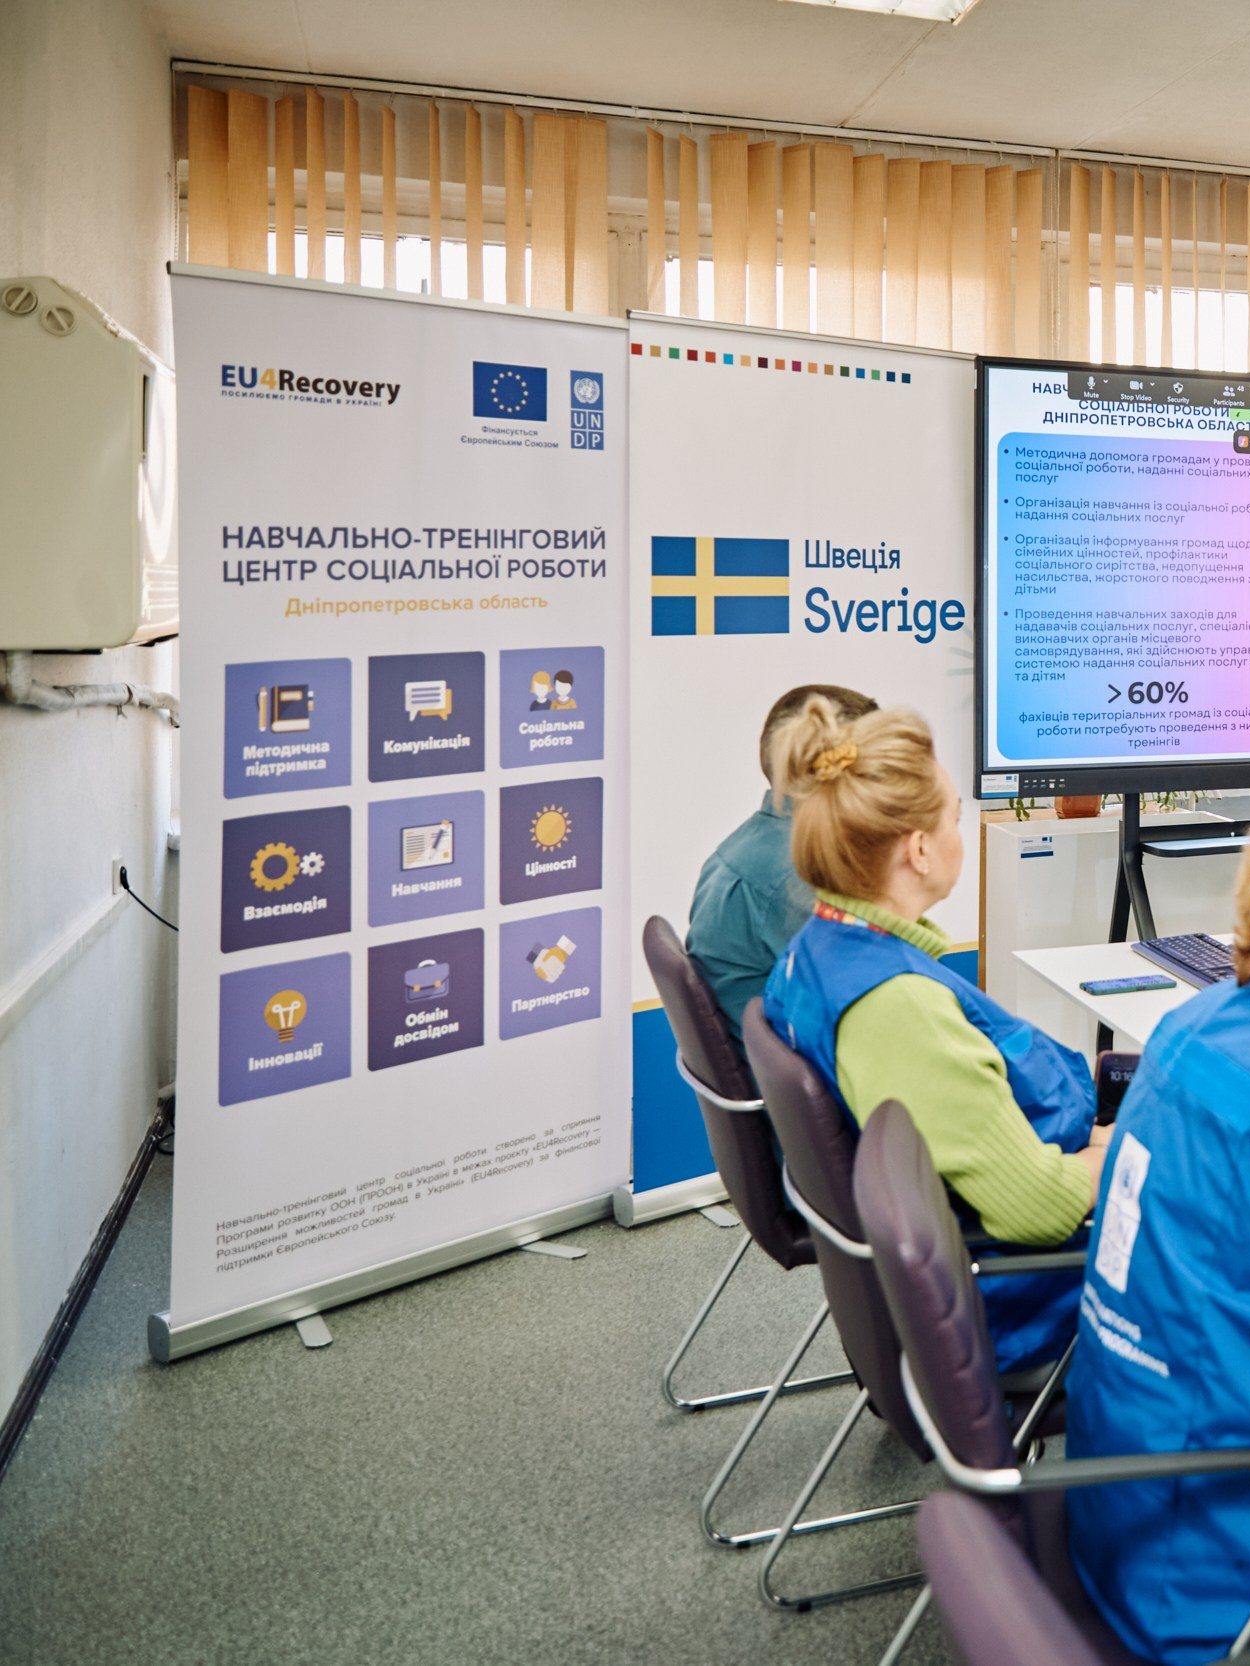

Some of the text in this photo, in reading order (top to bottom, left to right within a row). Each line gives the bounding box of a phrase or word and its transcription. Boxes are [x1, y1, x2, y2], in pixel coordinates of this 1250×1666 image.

[221, 364, 401, 405] EU4Recovery
[221, 390, 285, 400] ПОСИЛЮЄМО
[289, 395, 332, 404] ГРОМАДИ
[1121, 393, 1152, 402] Stop Video
[1167, 396, 1190, 404] Security
[1213, 399, 1245, 407] Participants
[1043, 412, 1194, 429] ДНІПРОПЕТРОВСЬКА
[481, 425, 538, 437] Фінансується
[460, 435, 559, 448] Європейським Союзом
[1015, 447, 1086, 463] Методична
[1088, 452, 1149, 465] допомога
[1151, 454, 1210, 468] громадам
[1213, 457, 1219, 468] у
[1014, 497, 1089, 512] Організація
[1092, 501, 1150, 511] навчання
[1153, 500, 1162, 511] із
[1165, 500, 1228, 514] соціальної
[222, 526, 606, 550] НАВЧАЛЬНО-ТРЕНІНГОВИЙ
[1014, 534, 1089, 549] Організація
[1092, 535, 1178, 550] інформування
[1181, 539, 1225, 551] громад
[804, 540, 900, 574] Швеція
[222, 554, 607, 586] ЦЕНТР СОЦІАЛЬНОЇ РОБОТИ
[285, 595, 548, 618] Дніпропетровська область
[804, 586, 966, 644] Sverige
[1015, 632, 1201, 646] виконавчих органів місцевого
[519, 719, 585, 736] Соціальна
[1036, 723, 1081, 738] роботи
[1084, 722, 1156, 737] потребують
[1158, 722, 1227, 735] проведення
[1230, 722, 1236, 730] з
[243, 740, 330, 761] Методична
[384, 734, 470, 756] Комунікація
[529, 734, 573, 751] робота
[245, 757, 326, 777] підтримка
[525, 856, 577, 876] Цінності
[392, 876, 462, 898] Навчання
[243, 896, 327, 921] Взаємодія
[512, 986, 590, 1014] Партнерство
[405, 1008, 449, 1027] Обмін
[394, 1021, 459, 1048] досвідом
[248, 1042, 323, 1072] Інновації
[216, 1211, 395, 1275] підтримки Європейського Союзу.
